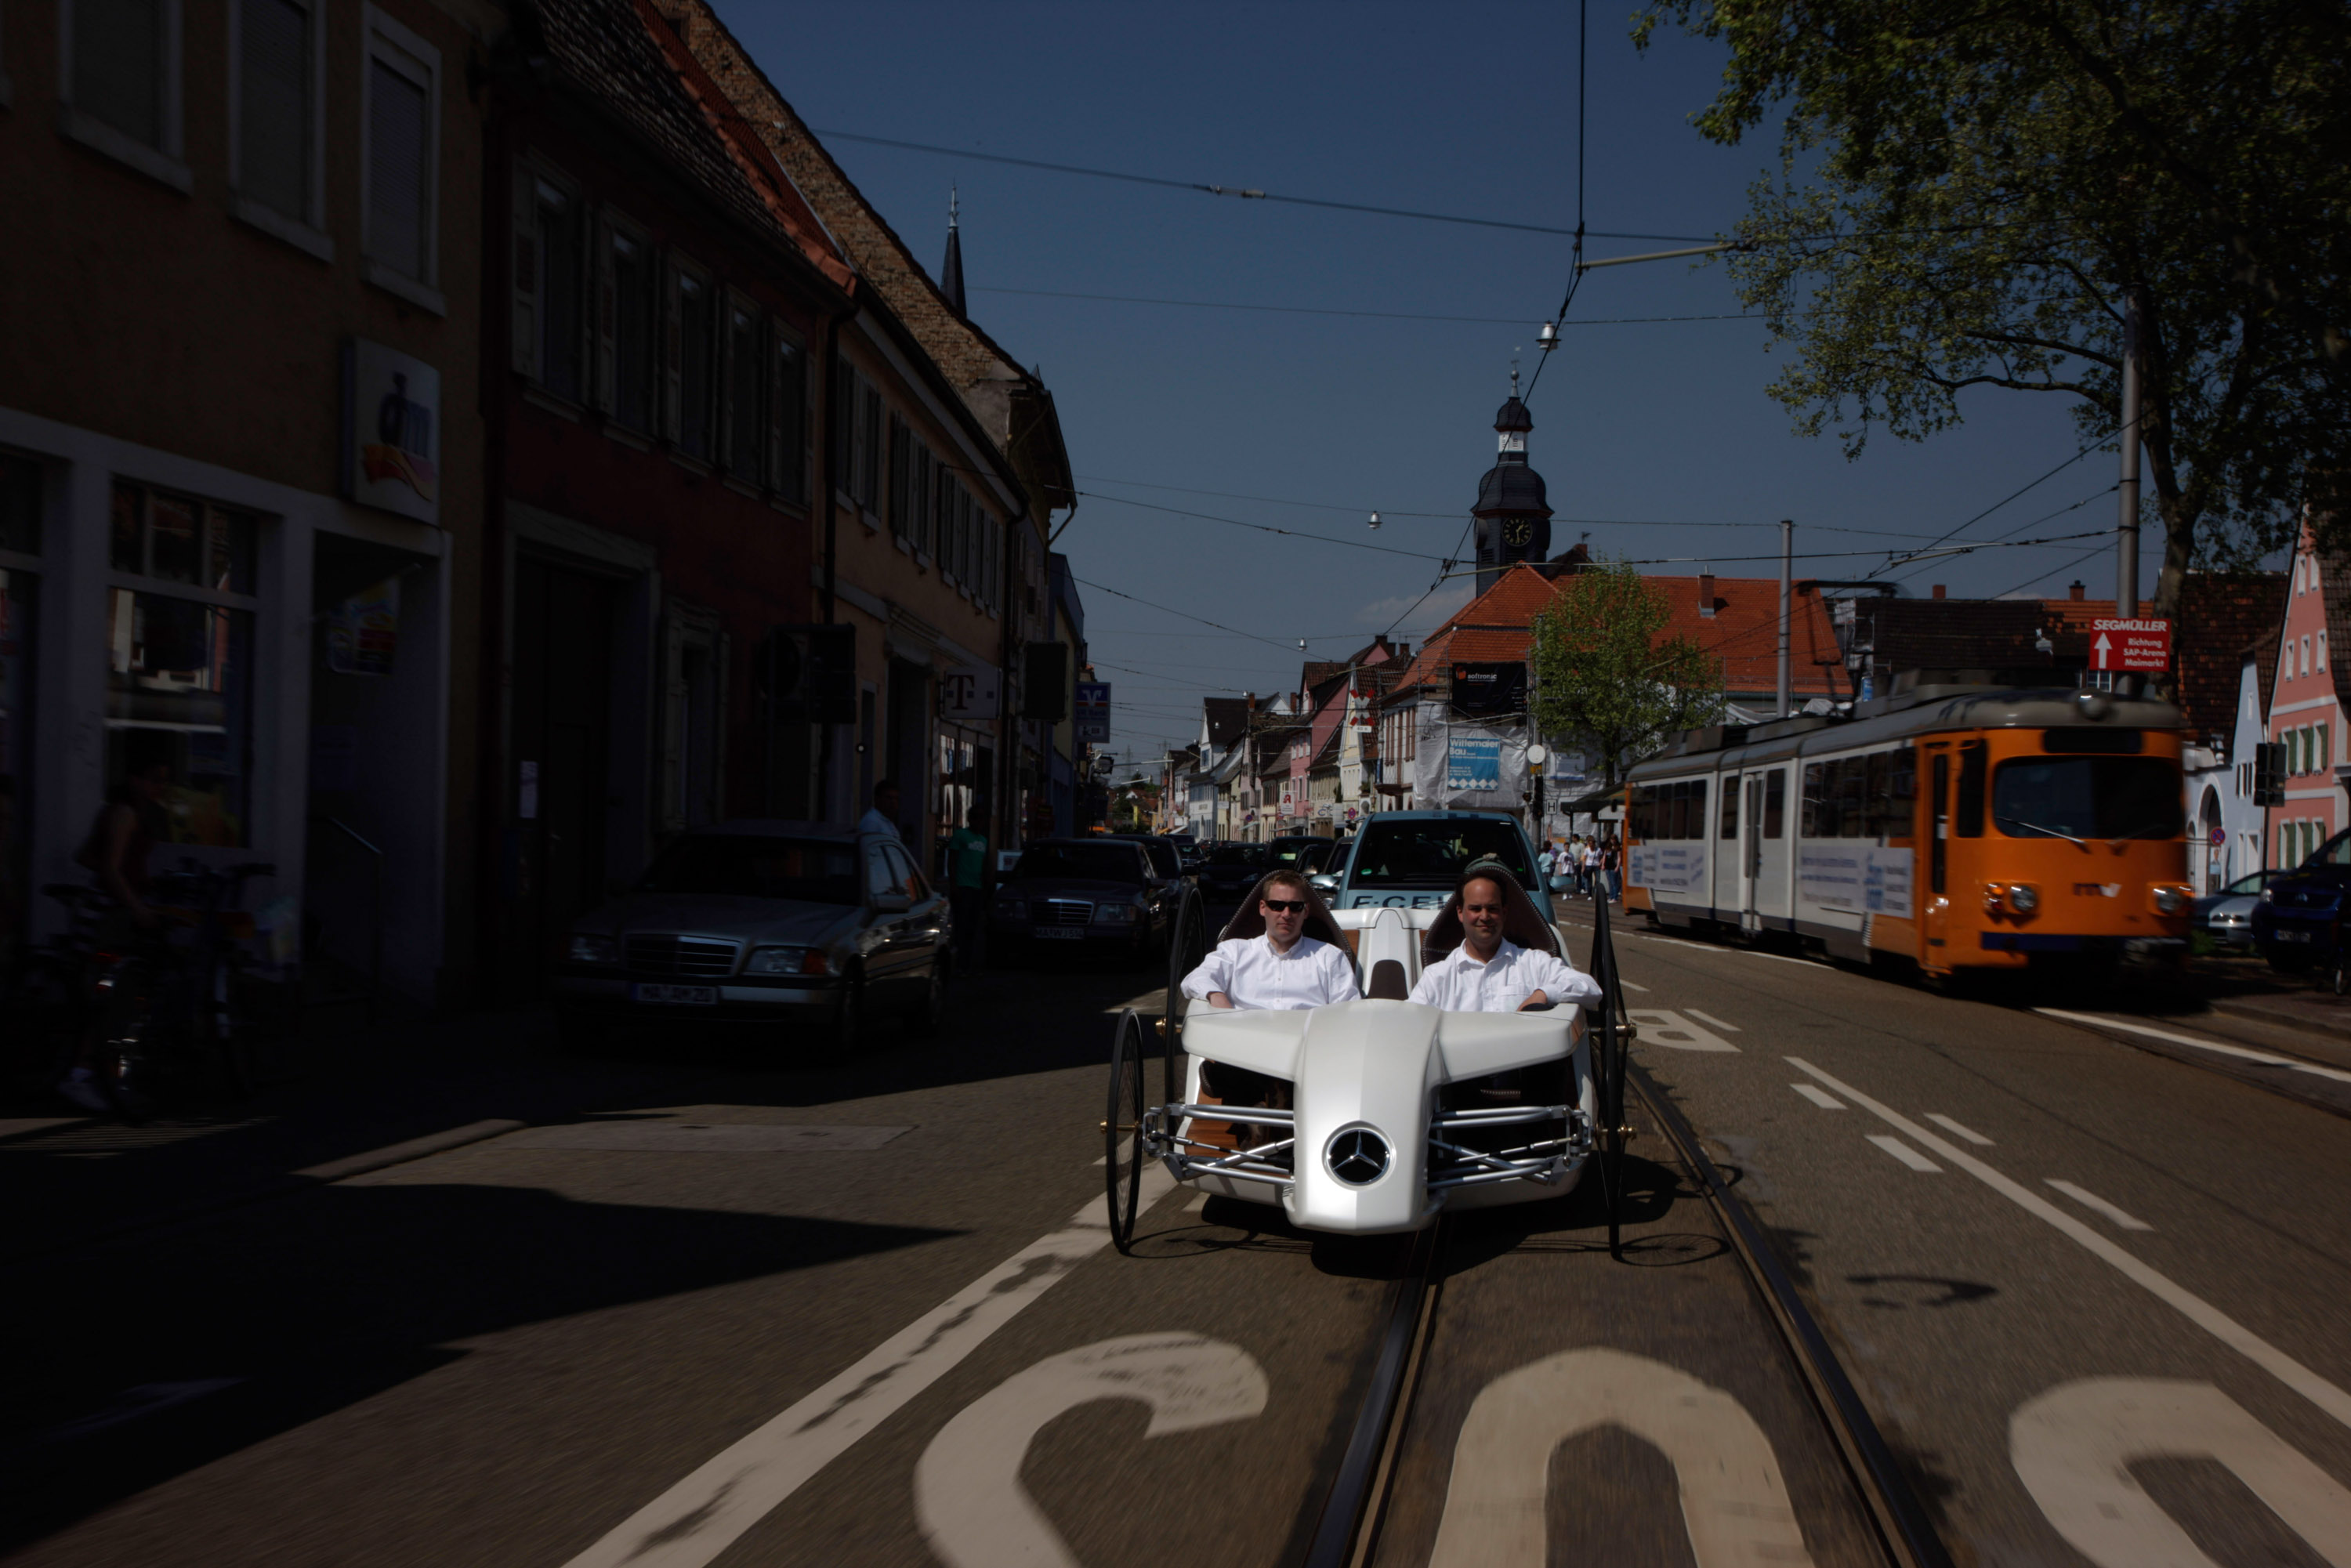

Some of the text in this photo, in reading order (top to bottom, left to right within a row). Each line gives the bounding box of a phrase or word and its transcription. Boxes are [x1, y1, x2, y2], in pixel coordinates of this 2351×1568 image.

[379, 371, 431, 458] dm
[2127, 637, 2163, 649] Richtung
[2123, 648, 2167, 657] SAP-Arena
[2125, 658, 2164, 668] Maimarkt
[947, 675, 975, 710] T
[1449, 747, 1466, 755] Bau
[1548, 802, 1556, 812] H
